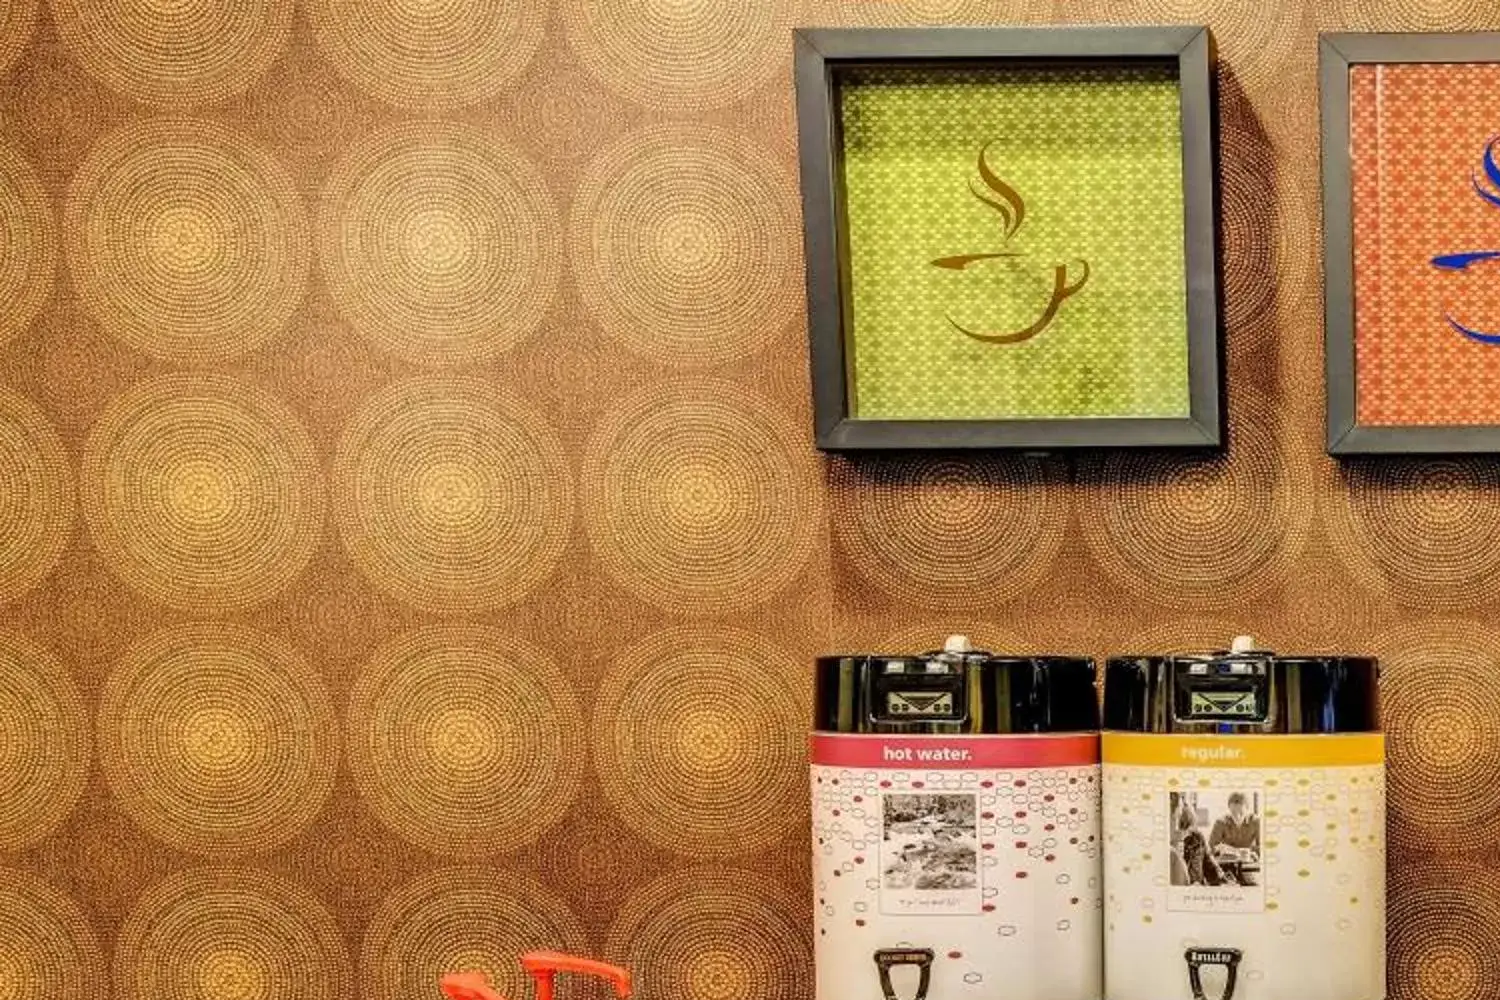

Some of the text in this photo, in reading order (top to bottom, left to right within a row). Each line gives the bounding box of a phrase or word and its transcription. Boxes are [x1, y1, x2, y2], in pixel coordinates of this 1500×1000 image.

[883, 745, 973, 761] hot water.
[1181, 744, 1247, 764] regular.
